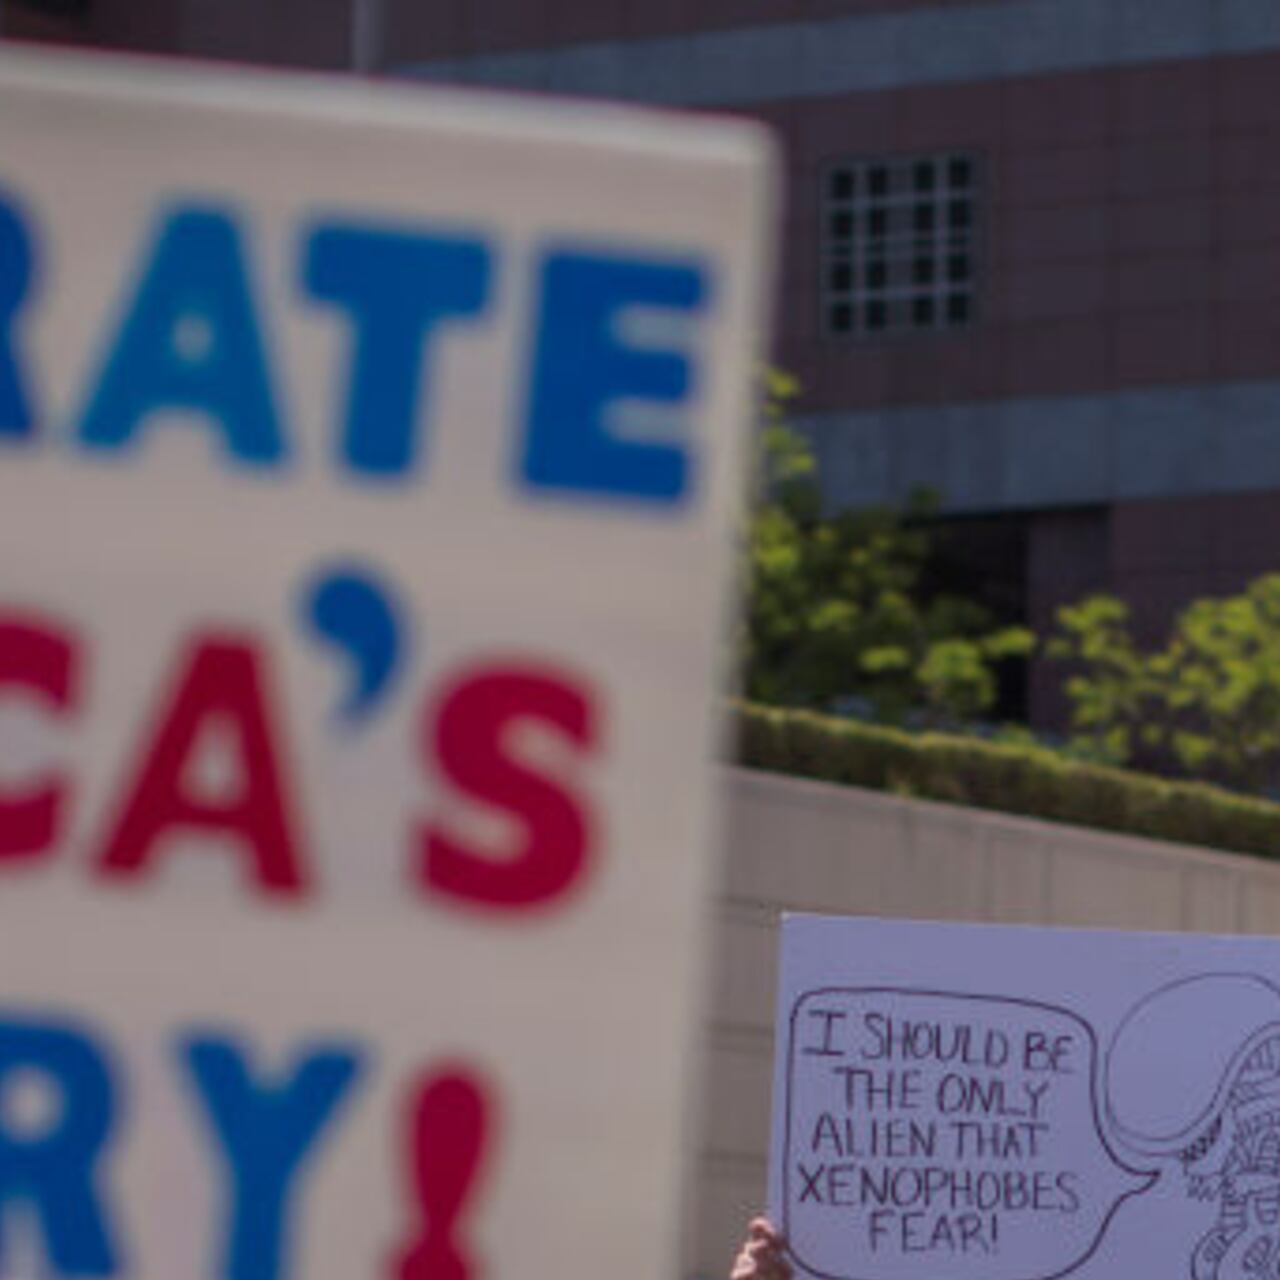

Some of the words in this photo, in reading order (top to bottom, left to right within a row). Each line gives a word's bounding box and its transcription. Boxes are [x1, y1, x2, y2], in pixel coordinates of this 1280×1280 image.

[801, 1010, 846, 1056] I
[860, 1012, 1008, 1068] SHOULD
[1022, 1032, 1074, 1074] BE
[834, 1068, 921, 1112] THE
[936, 1073, 1049, 1120] ONLY
[811, 1114, 935, 1158] ALIEN
[949, 1119, 1049, 1160] THAT
[796, 1163, 1080, 1214] XENOPHOBES
[868, 1211, 998, 1255] FEAR!
